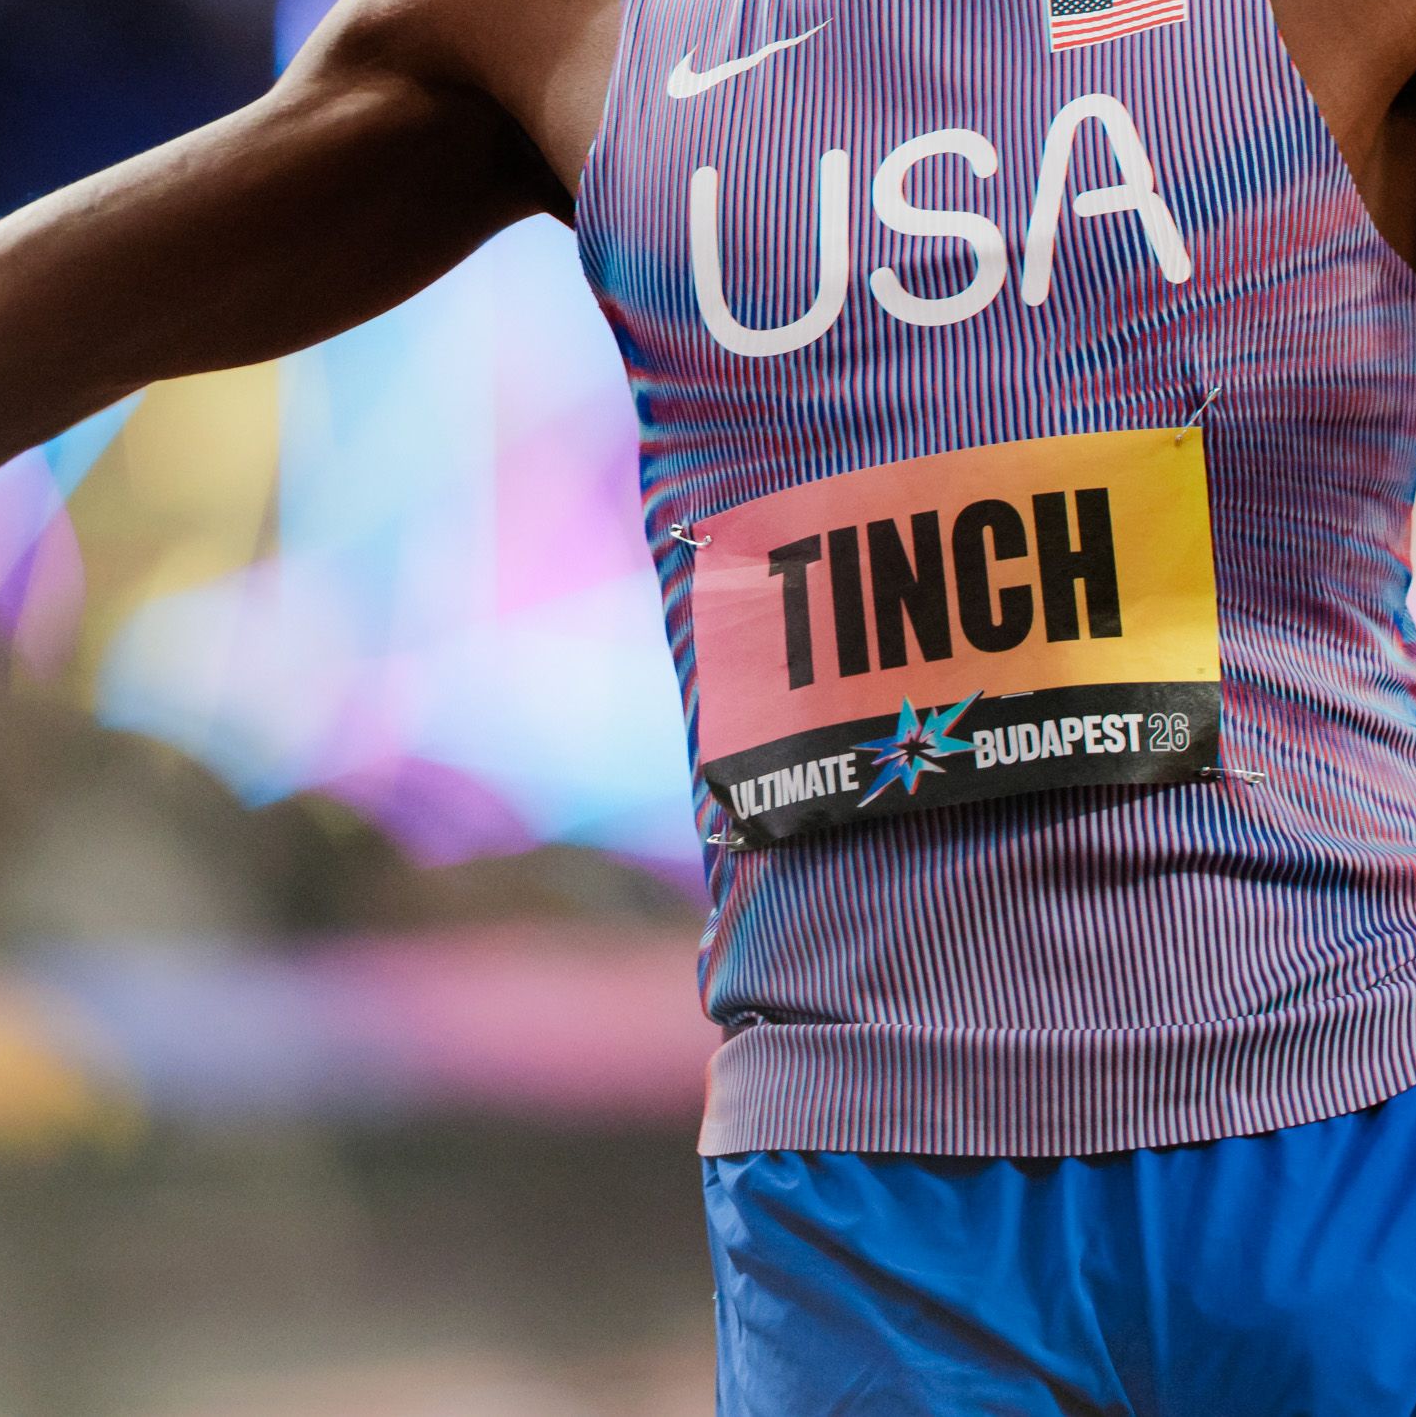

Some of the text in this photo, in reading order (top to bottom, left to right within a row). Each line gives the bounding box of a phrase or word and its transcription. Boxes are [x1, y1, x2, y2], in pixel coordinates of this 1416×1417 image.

[690, 93, 1191, 357] USA
[767, 487, 1123, 691] TINCH
[729, 713, 1190, 821] ULTIMATE BUDAPEST 26
